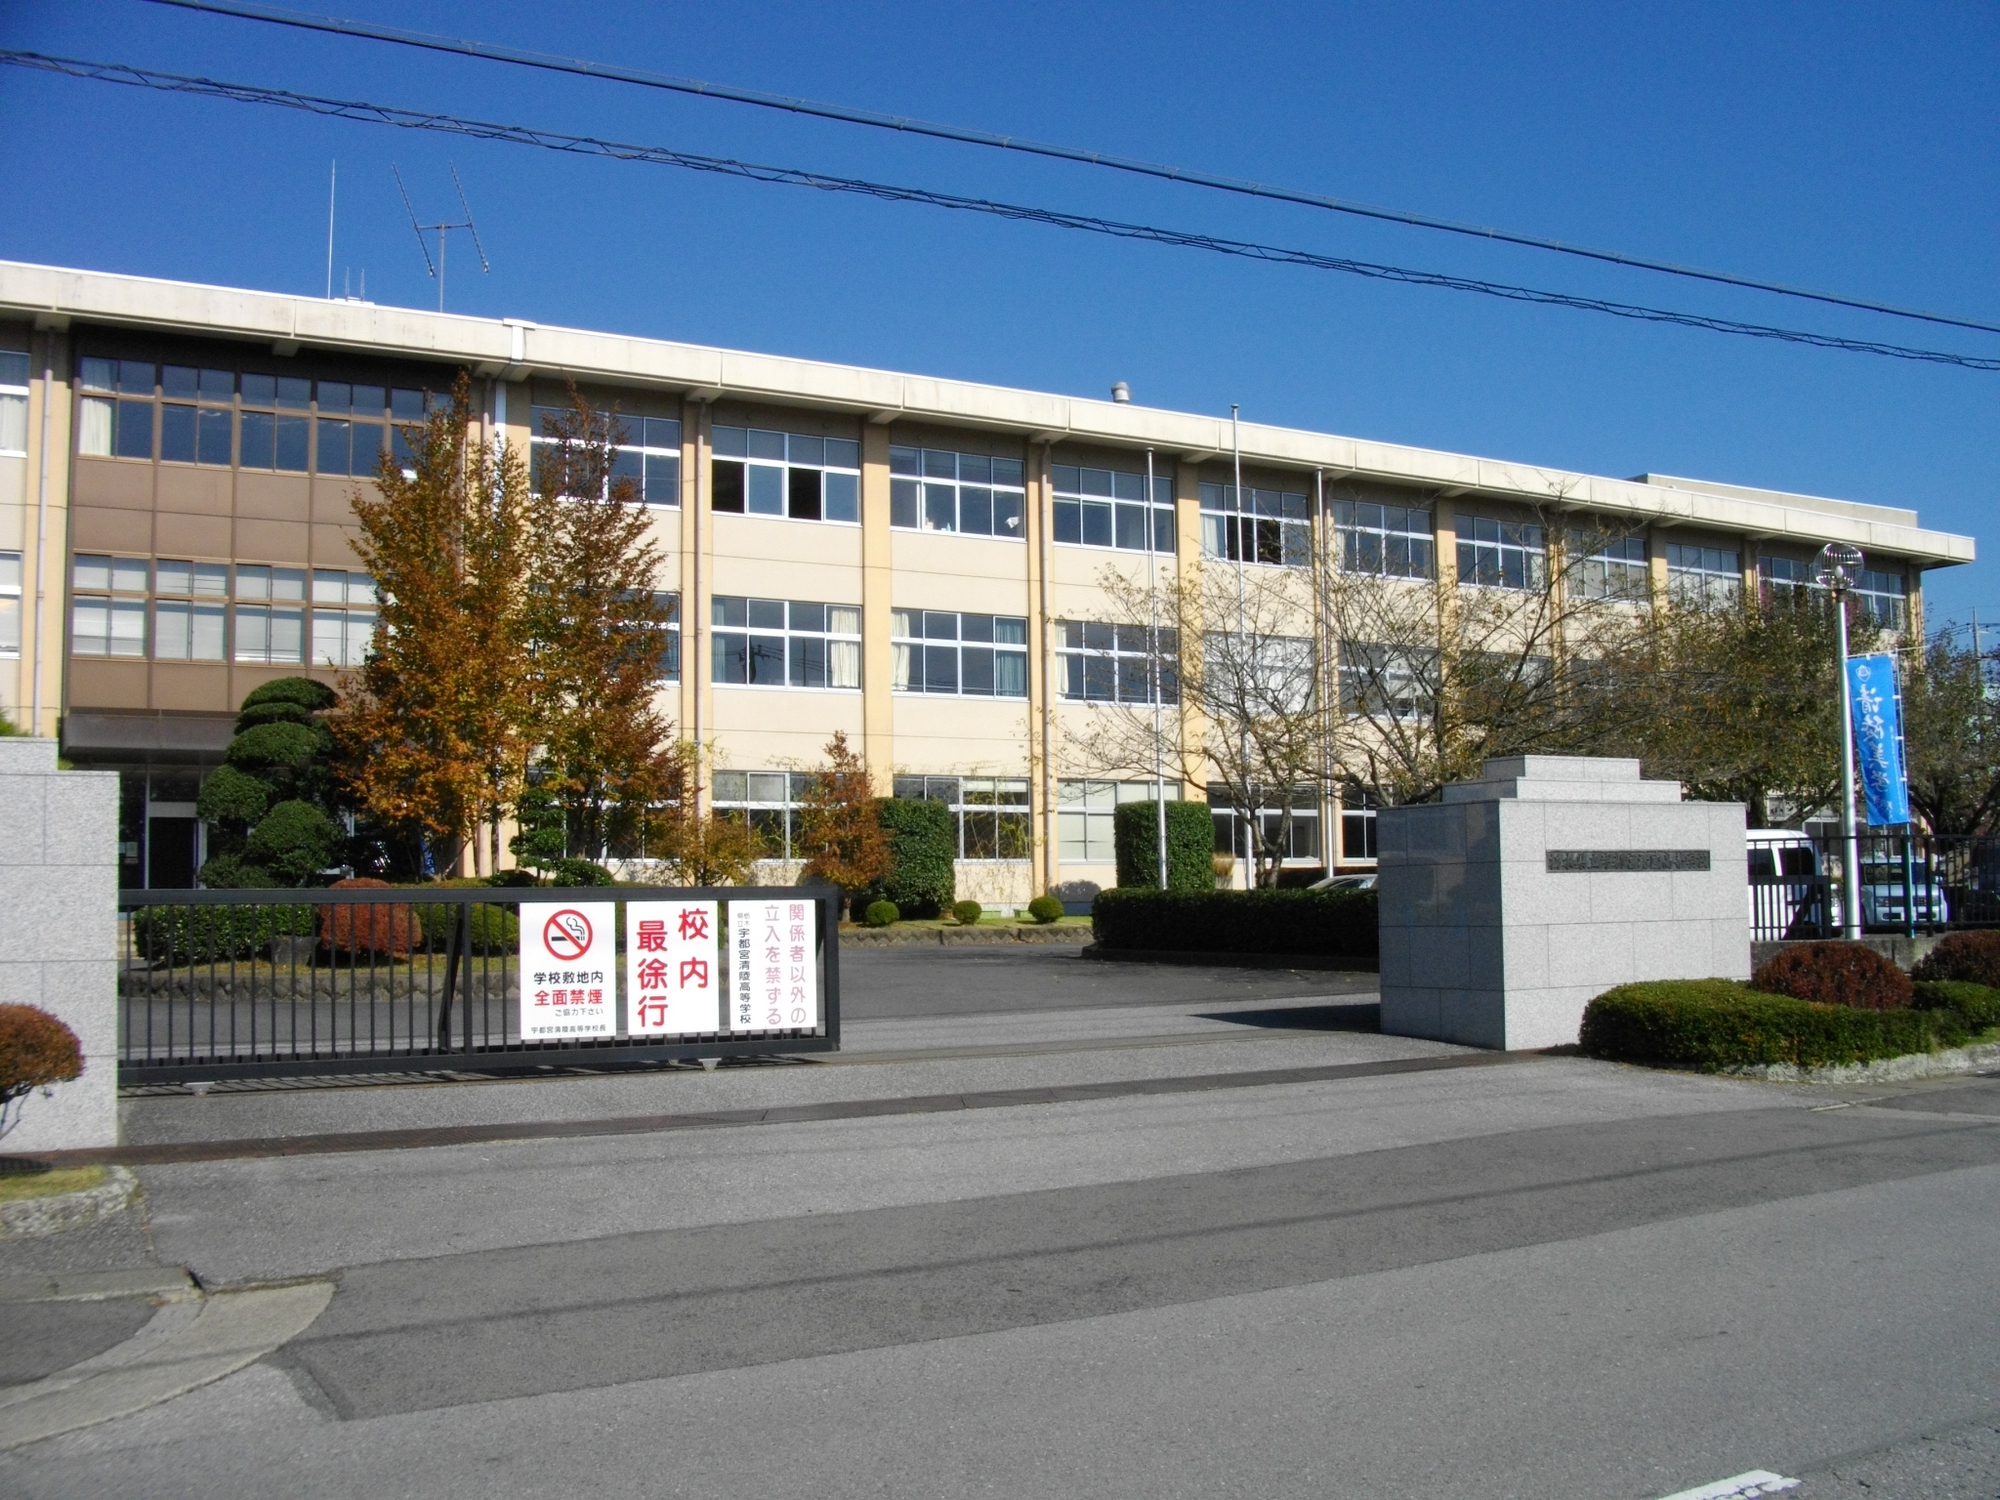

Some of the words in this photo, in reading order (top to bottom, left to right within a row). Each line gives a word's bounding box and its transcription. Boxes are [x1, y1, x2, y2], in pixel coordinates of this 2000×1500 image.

[533, 970, 604, 985] 学校敷地内
[636, 919, 668, 1028] 最徐行
[678, 907, 709, 990] 校内
[738, 928, 751, 1024] 宇都宮清陵高等学校
[764, 904, 782, 1025] 立入を禁ずる
[788, 903, 807, 1024] 関係者以外の
[534, 988, 603, 1006] 全面禁煙
[554, 1007, 604, 1017] ご協力下さい
